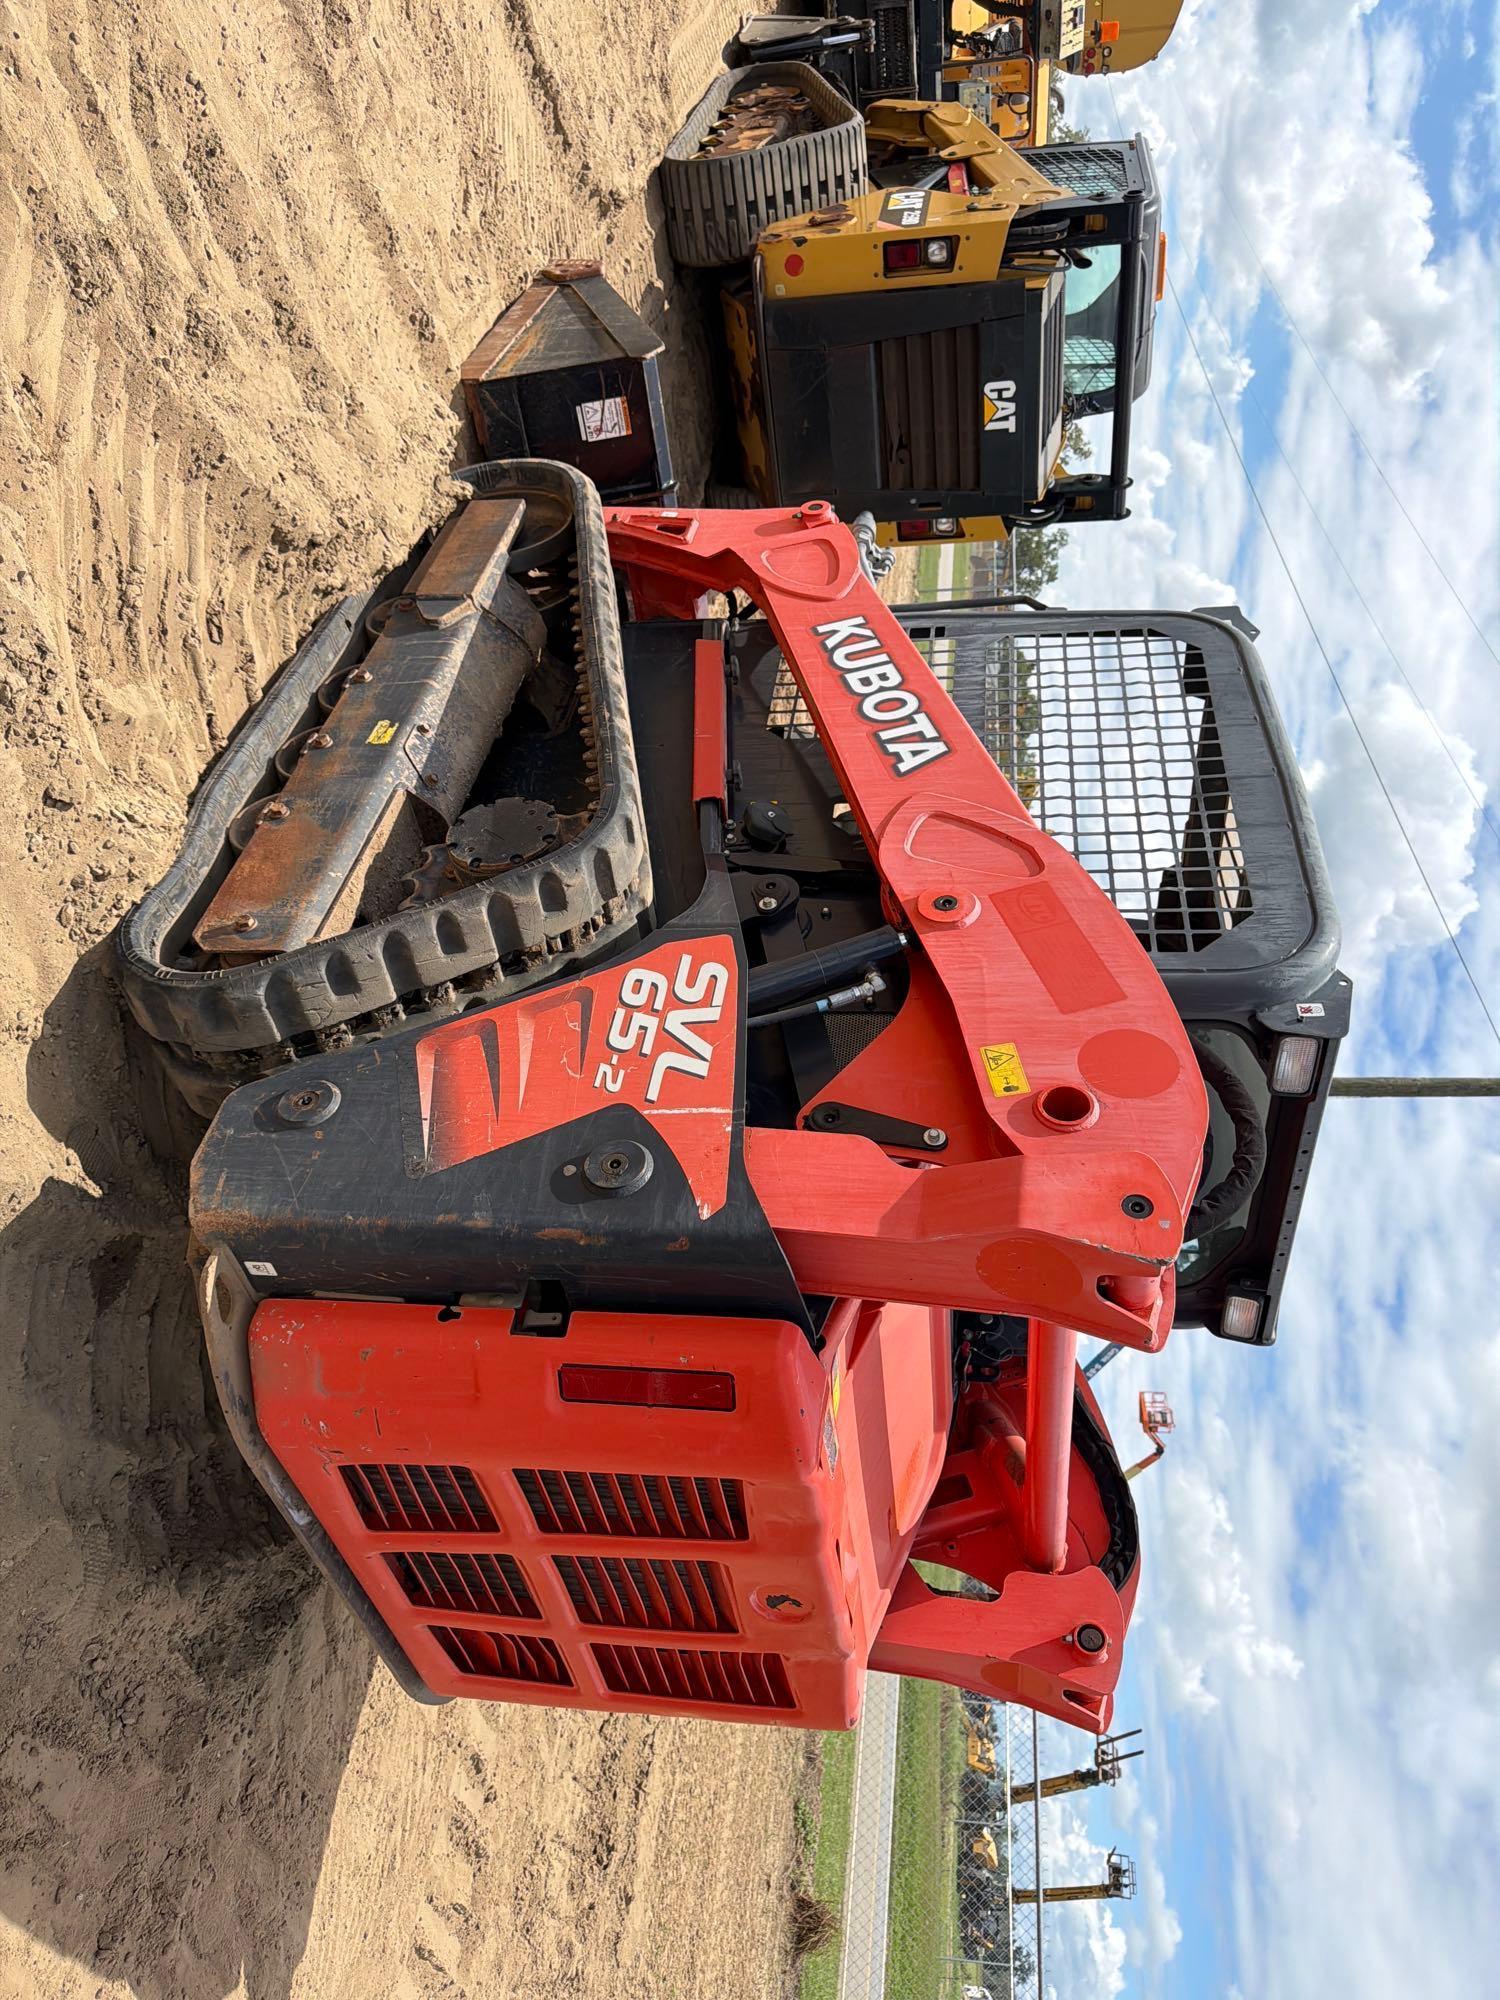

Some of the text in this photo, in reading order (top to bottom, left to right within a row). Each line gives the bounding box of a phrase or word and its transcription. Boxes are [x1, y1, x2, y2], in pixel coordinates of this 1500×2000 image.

[887, 191, 926, 210] CAT
[984, 380, 1016, 433] CAT
[813, 615, 949, 773] KUBOTA
[593, 967, 668, 1094] 65-2
[645, 953, 729, 1102] SVL
